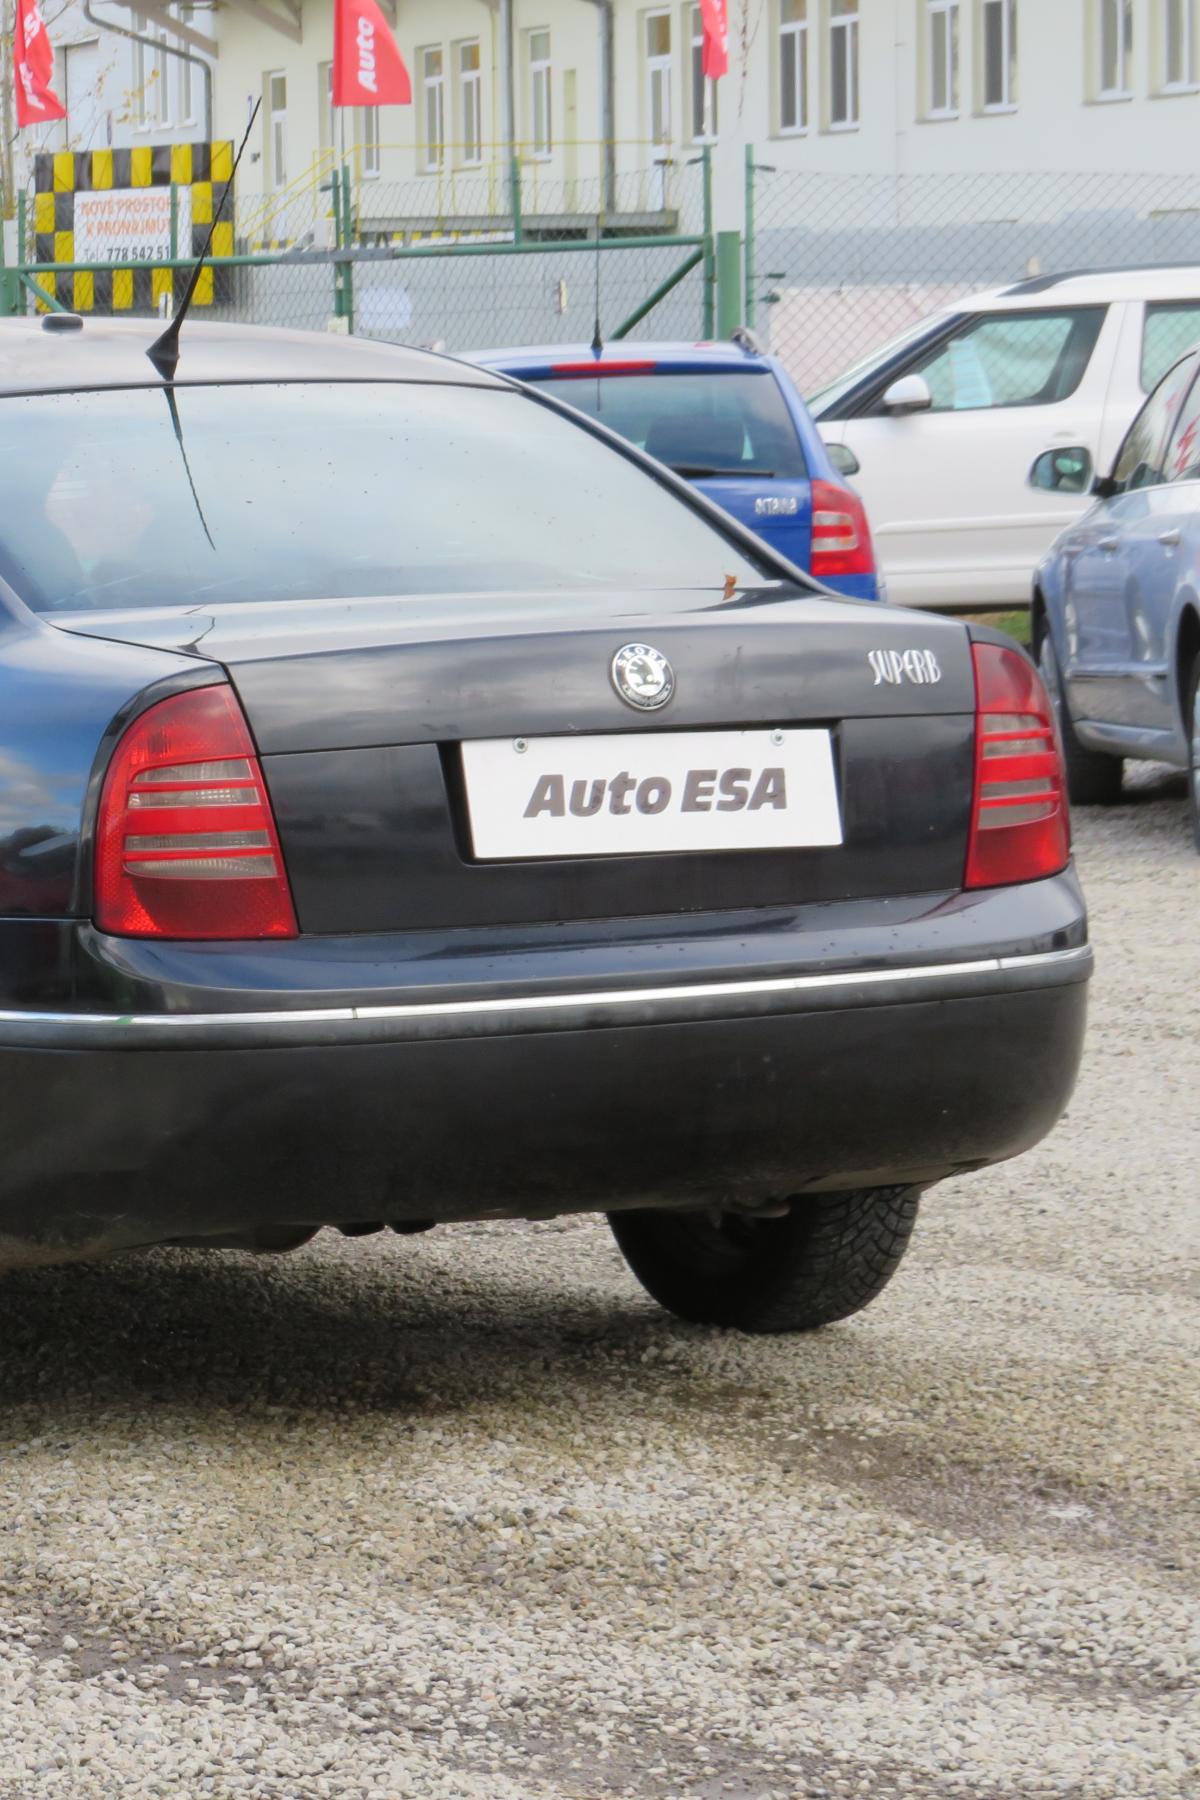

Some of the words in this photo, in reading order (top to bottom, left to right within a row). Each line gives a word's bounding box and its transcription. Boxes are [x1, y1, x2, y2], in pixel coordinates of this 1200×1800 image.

[357, 16, 377, 93] Auto
[106, 247, 129, 263] 778
[131, 245, 154, 261] 542
[868, 649, 942, 686] SUPERB
[523, 771, 672, 818] Auto
[681, 767, 788, 813] ESA
